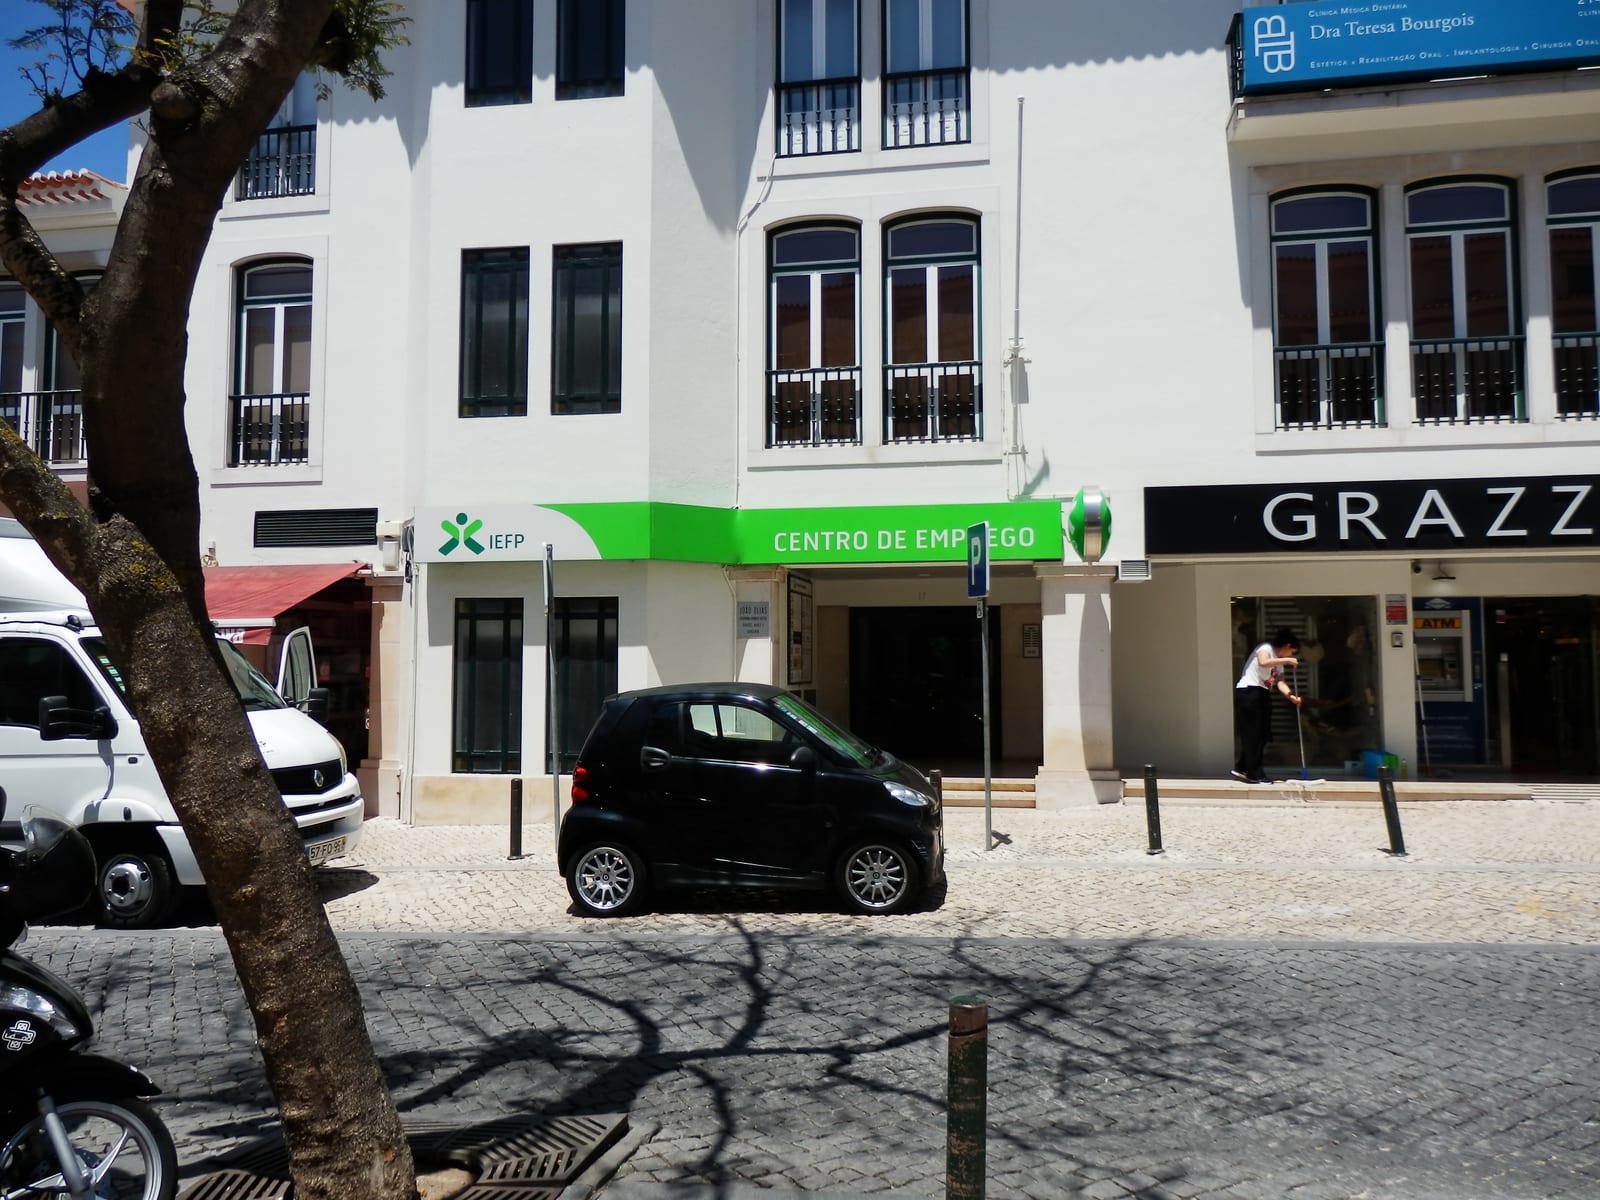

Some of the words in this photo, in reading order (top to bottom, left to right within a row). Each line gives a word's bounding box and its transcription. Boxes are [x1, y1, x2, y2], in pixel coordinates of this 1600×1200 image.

[1310, 24, 1341, 40] Dra
[1344, 20, 1396, 37] Teresa
[1400, 12, 1475, 33] Bourgois
[490, 534, 525, 550] IEFP
[774, 530, 868, 552] CENTRO
[877, 529, 907, 550] DE
[915, 526, 1036, 549] EMPEGO
[970, 536, 981, 586] P
[1422, 618, 1455, 629] ATM
